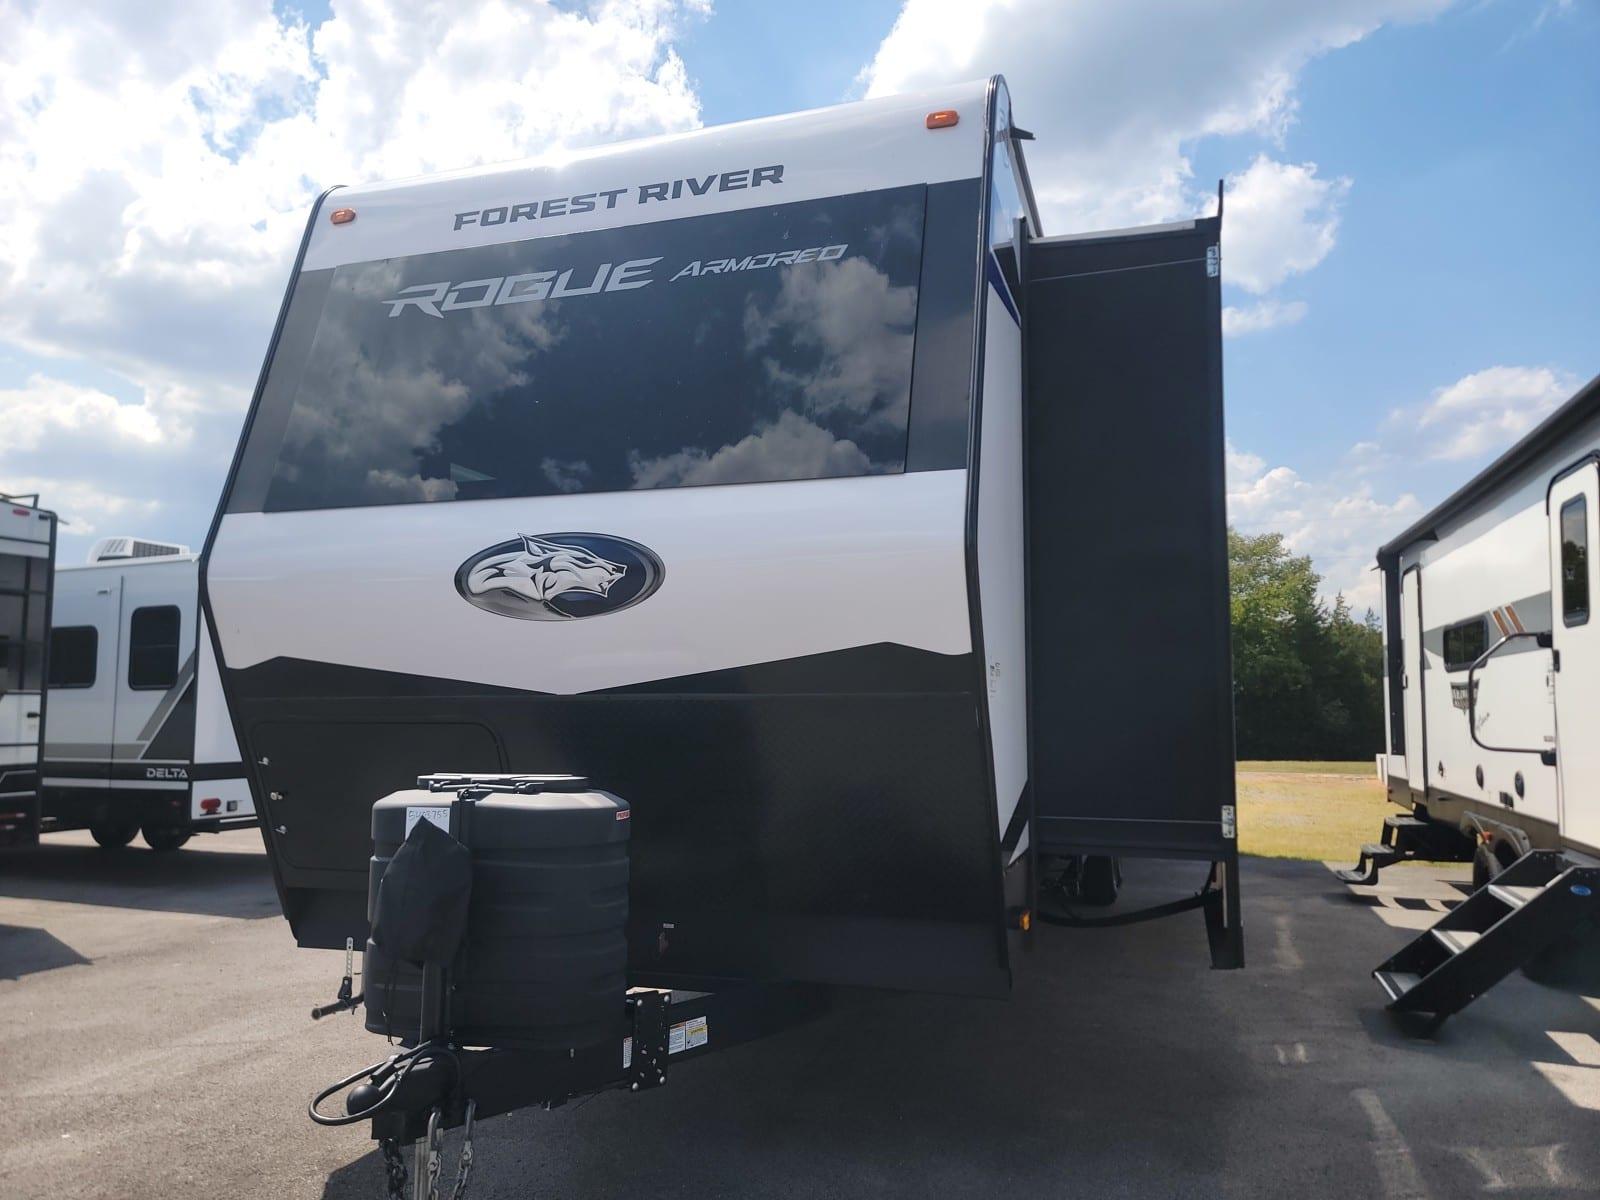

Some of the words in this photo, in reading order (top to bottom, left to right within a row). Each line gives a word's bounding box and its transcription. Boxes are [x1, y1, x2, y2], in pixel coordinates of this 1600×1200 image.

[453, 188, 628, 231] FOREST
[638, 164, 785, 205] RIVER
[381, 256, 665, 319] ROGUE
[669, 243, 849, 282] ARMORED
[145, 767, 188, 778] DELTA
